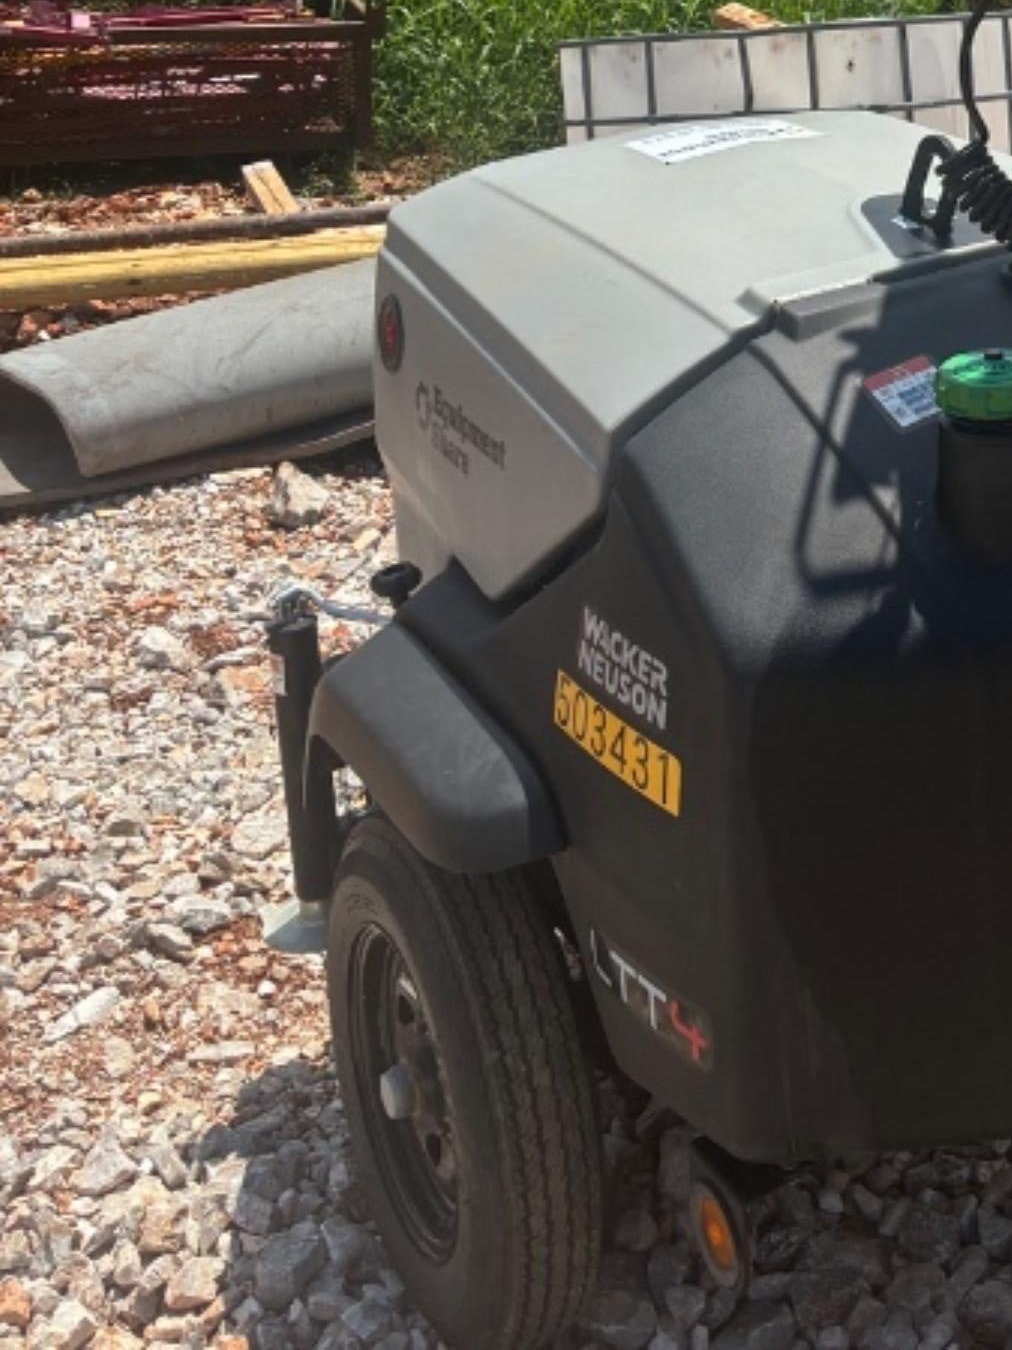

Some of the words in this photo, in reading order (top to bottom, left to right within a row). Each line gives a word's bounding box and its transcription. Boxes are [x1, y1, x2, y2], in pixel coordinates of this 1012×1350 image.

[577, 639, 668, 731] NEUSON
[582, 605, 668, 698] WACKER
[556, 673, 670, 805] 503431
[589, 928, 711, 1062] LTT4
